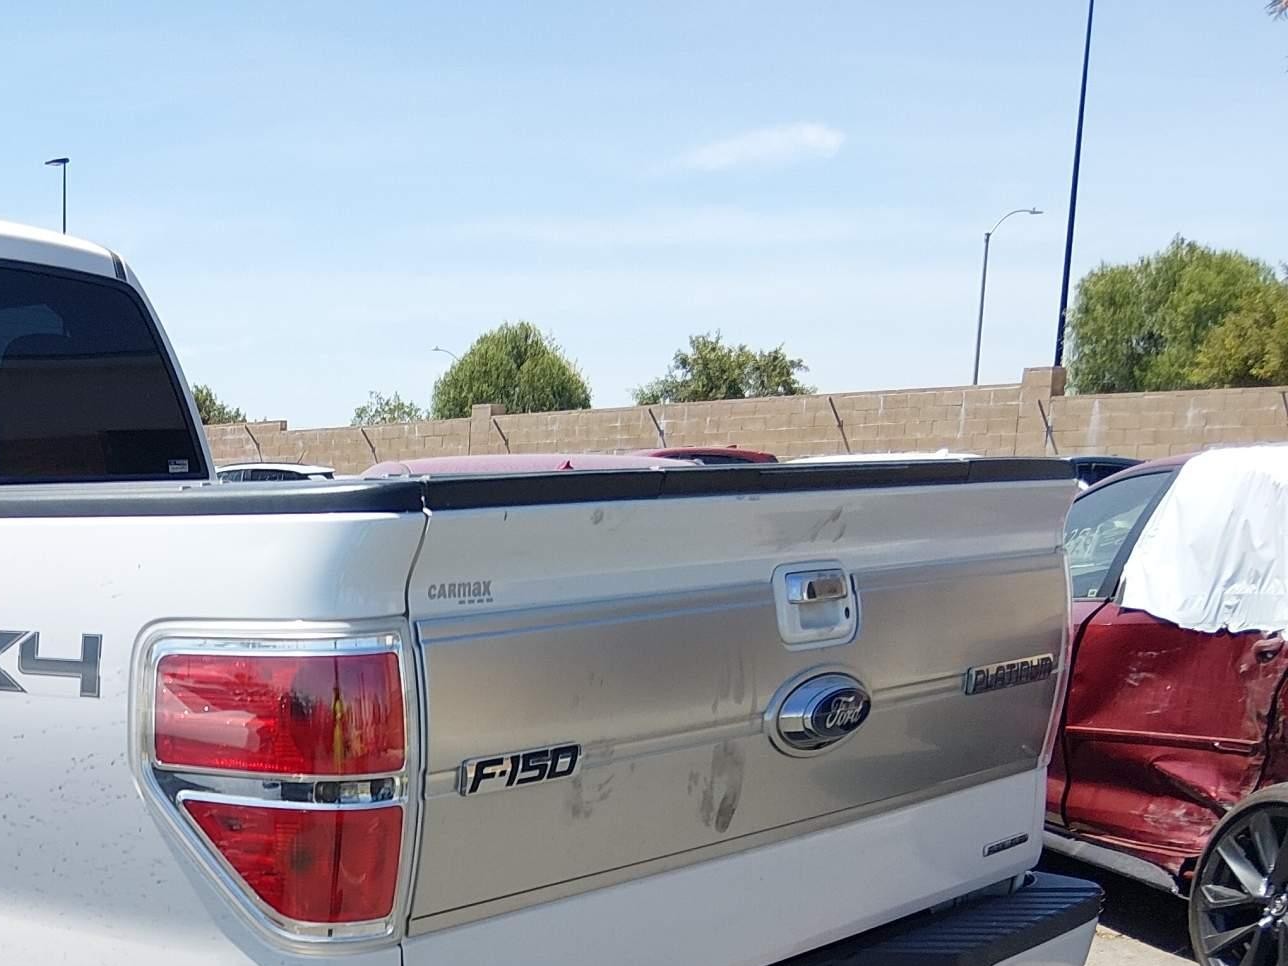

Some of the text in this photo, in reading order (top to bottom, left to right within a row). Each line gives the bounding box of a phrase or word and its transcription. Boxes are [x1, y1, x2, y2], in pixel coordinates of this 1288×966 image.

[972, 655, 1053, 694] PLATINUM
[825, 695, 864, 729] Ford
[468, 744, 580, 794] F-150
